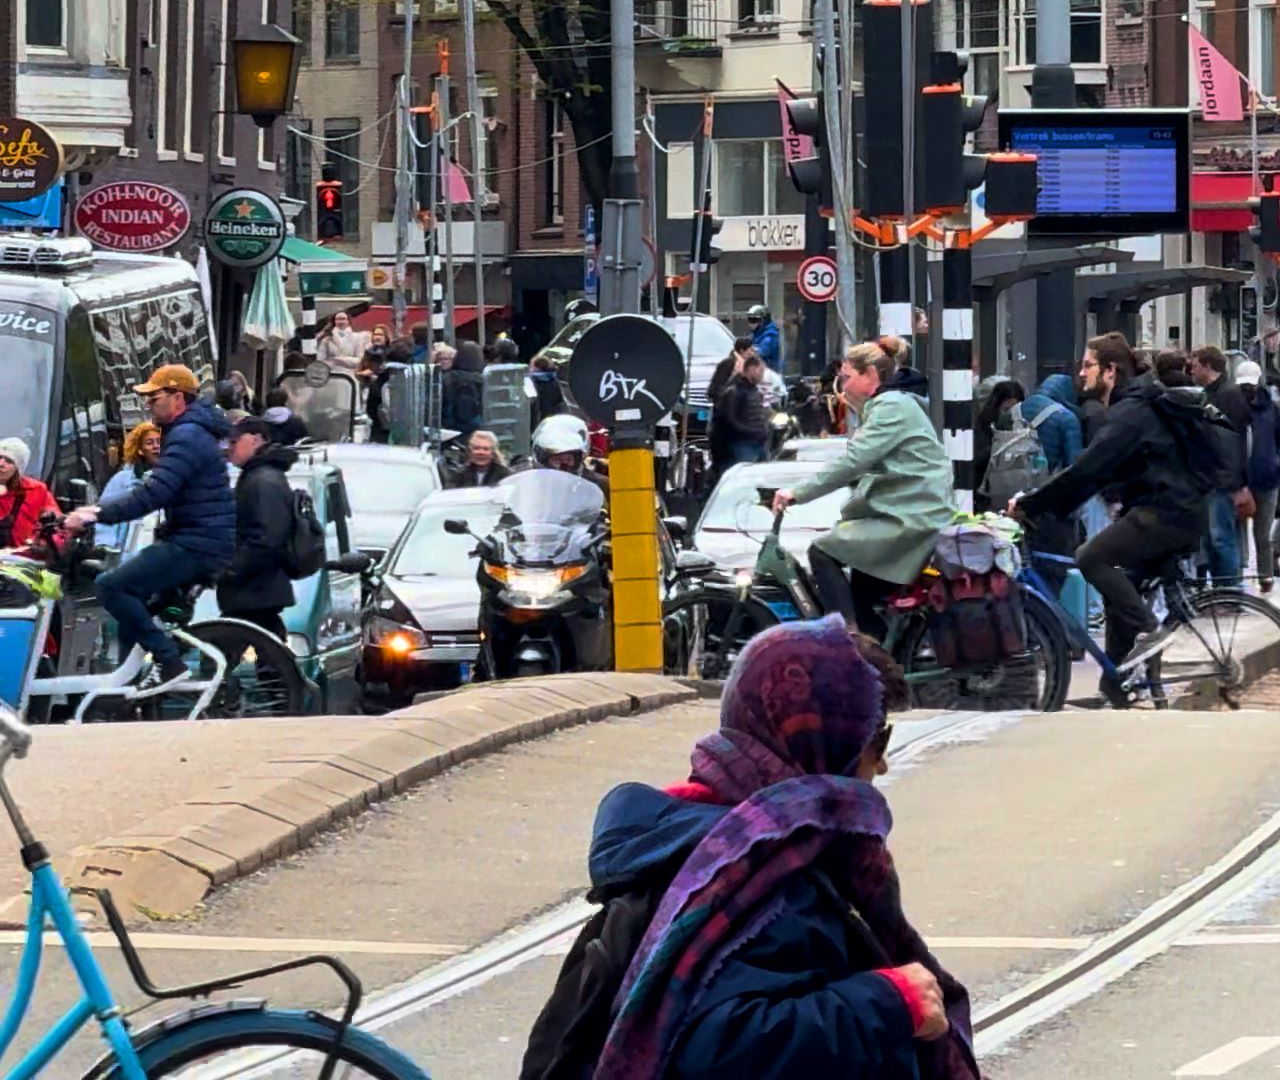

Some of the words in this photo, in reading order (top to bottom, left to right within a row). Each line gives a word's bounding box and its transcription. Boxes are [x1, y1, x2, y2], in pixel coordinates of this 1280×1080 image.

[82, 185, 184, 218] KOH-I-NOOR
[102, 209, 163, 224] INDIAN
[84, 221, 181, 248] RESTAURANT
[210, 221, 278, 236] Heineken
[807, 271, 833, 288] 30
